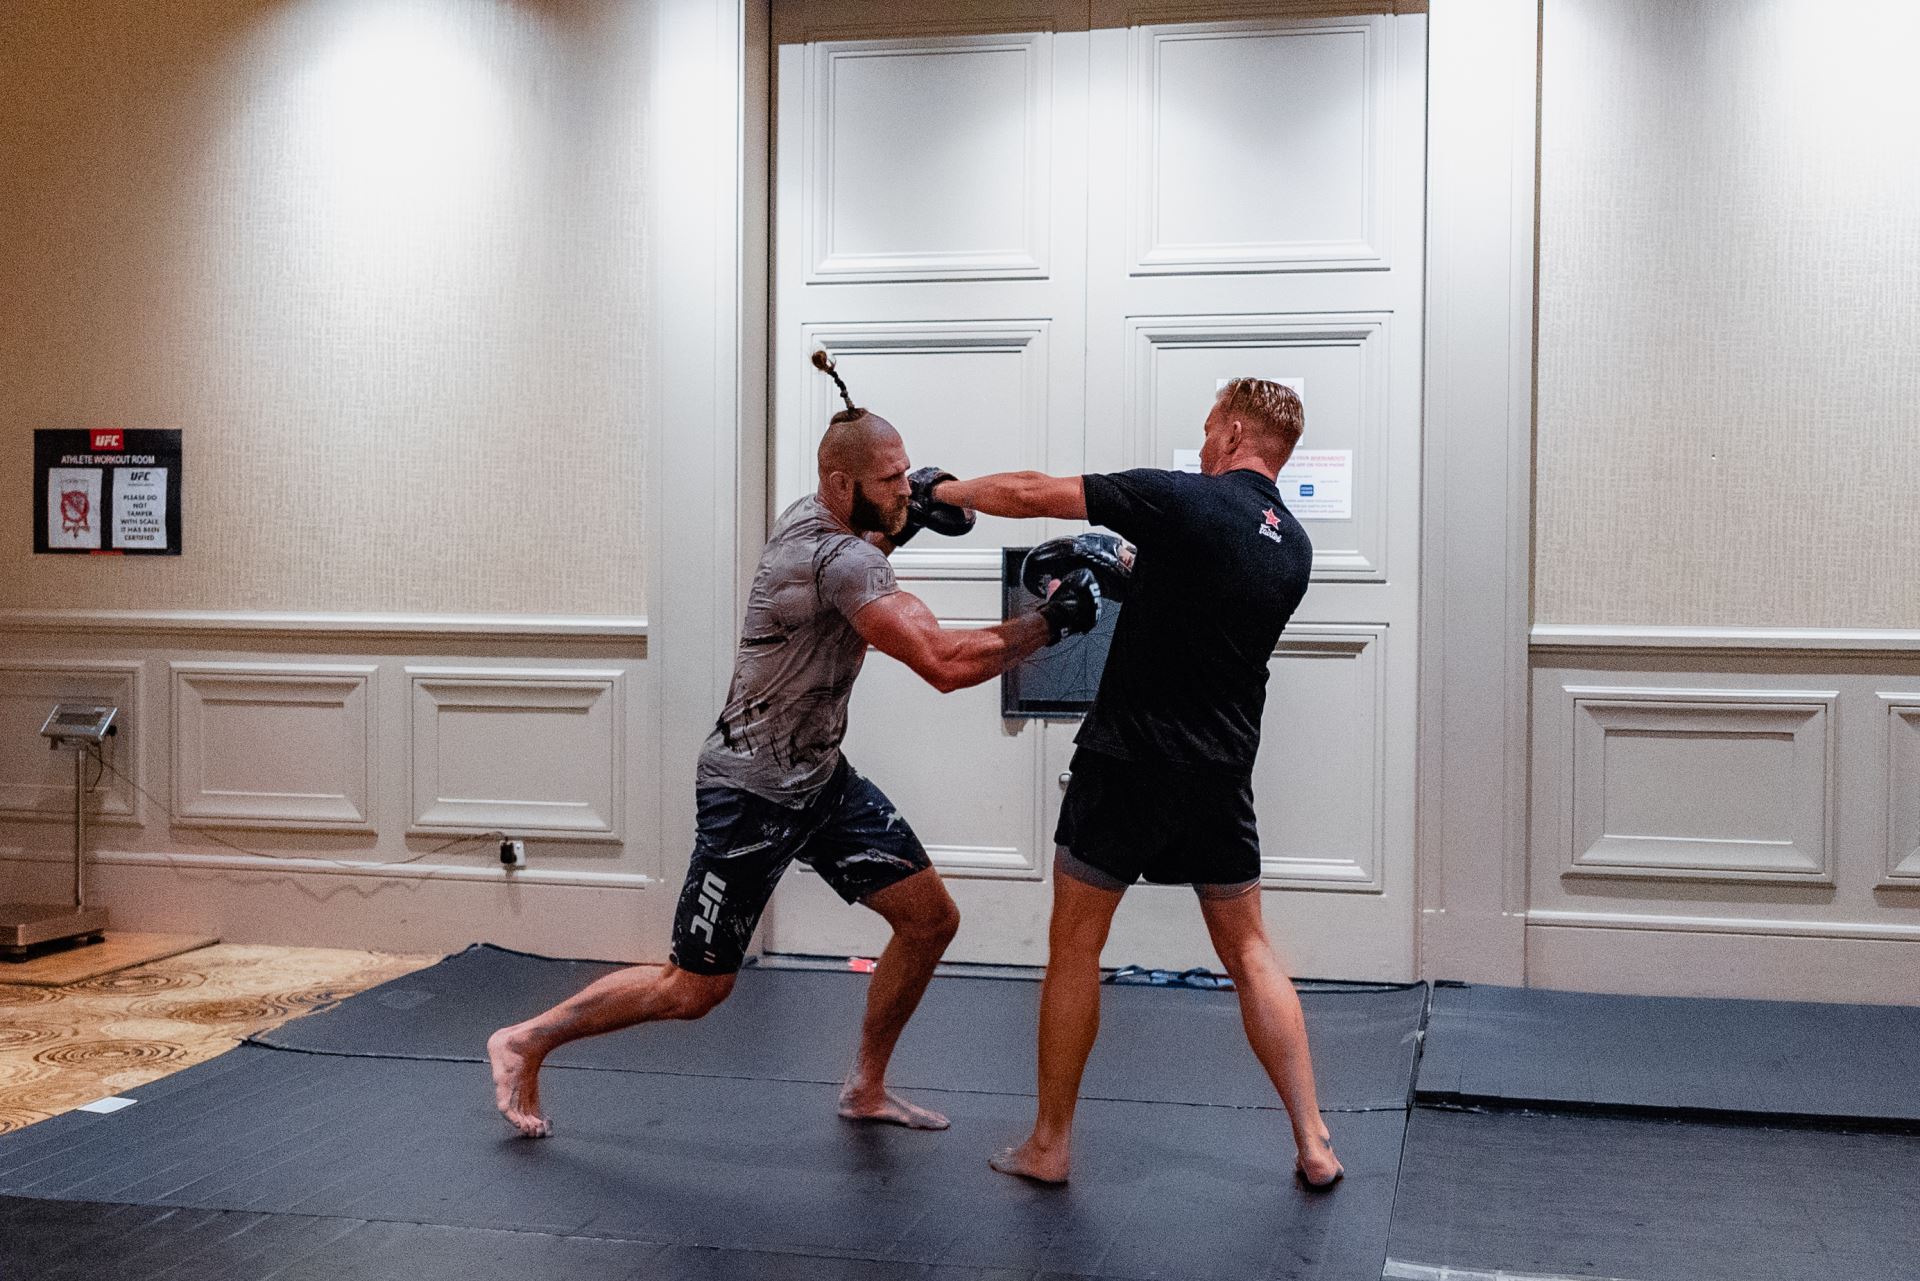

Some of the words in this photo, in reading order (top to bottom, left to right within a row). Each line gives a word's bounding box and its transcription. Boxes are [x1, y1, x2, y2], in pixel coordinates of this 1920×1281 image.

[95, 435, 120, 446] UFC
[61, 455, 93, 464] ATHLETE
[94, 455, 130, 464] WORKOUT
[131, 455, 155, 464] ROOM
[130, 471, 151, 481] UFC
[690, 871, 726, 944] UFC
